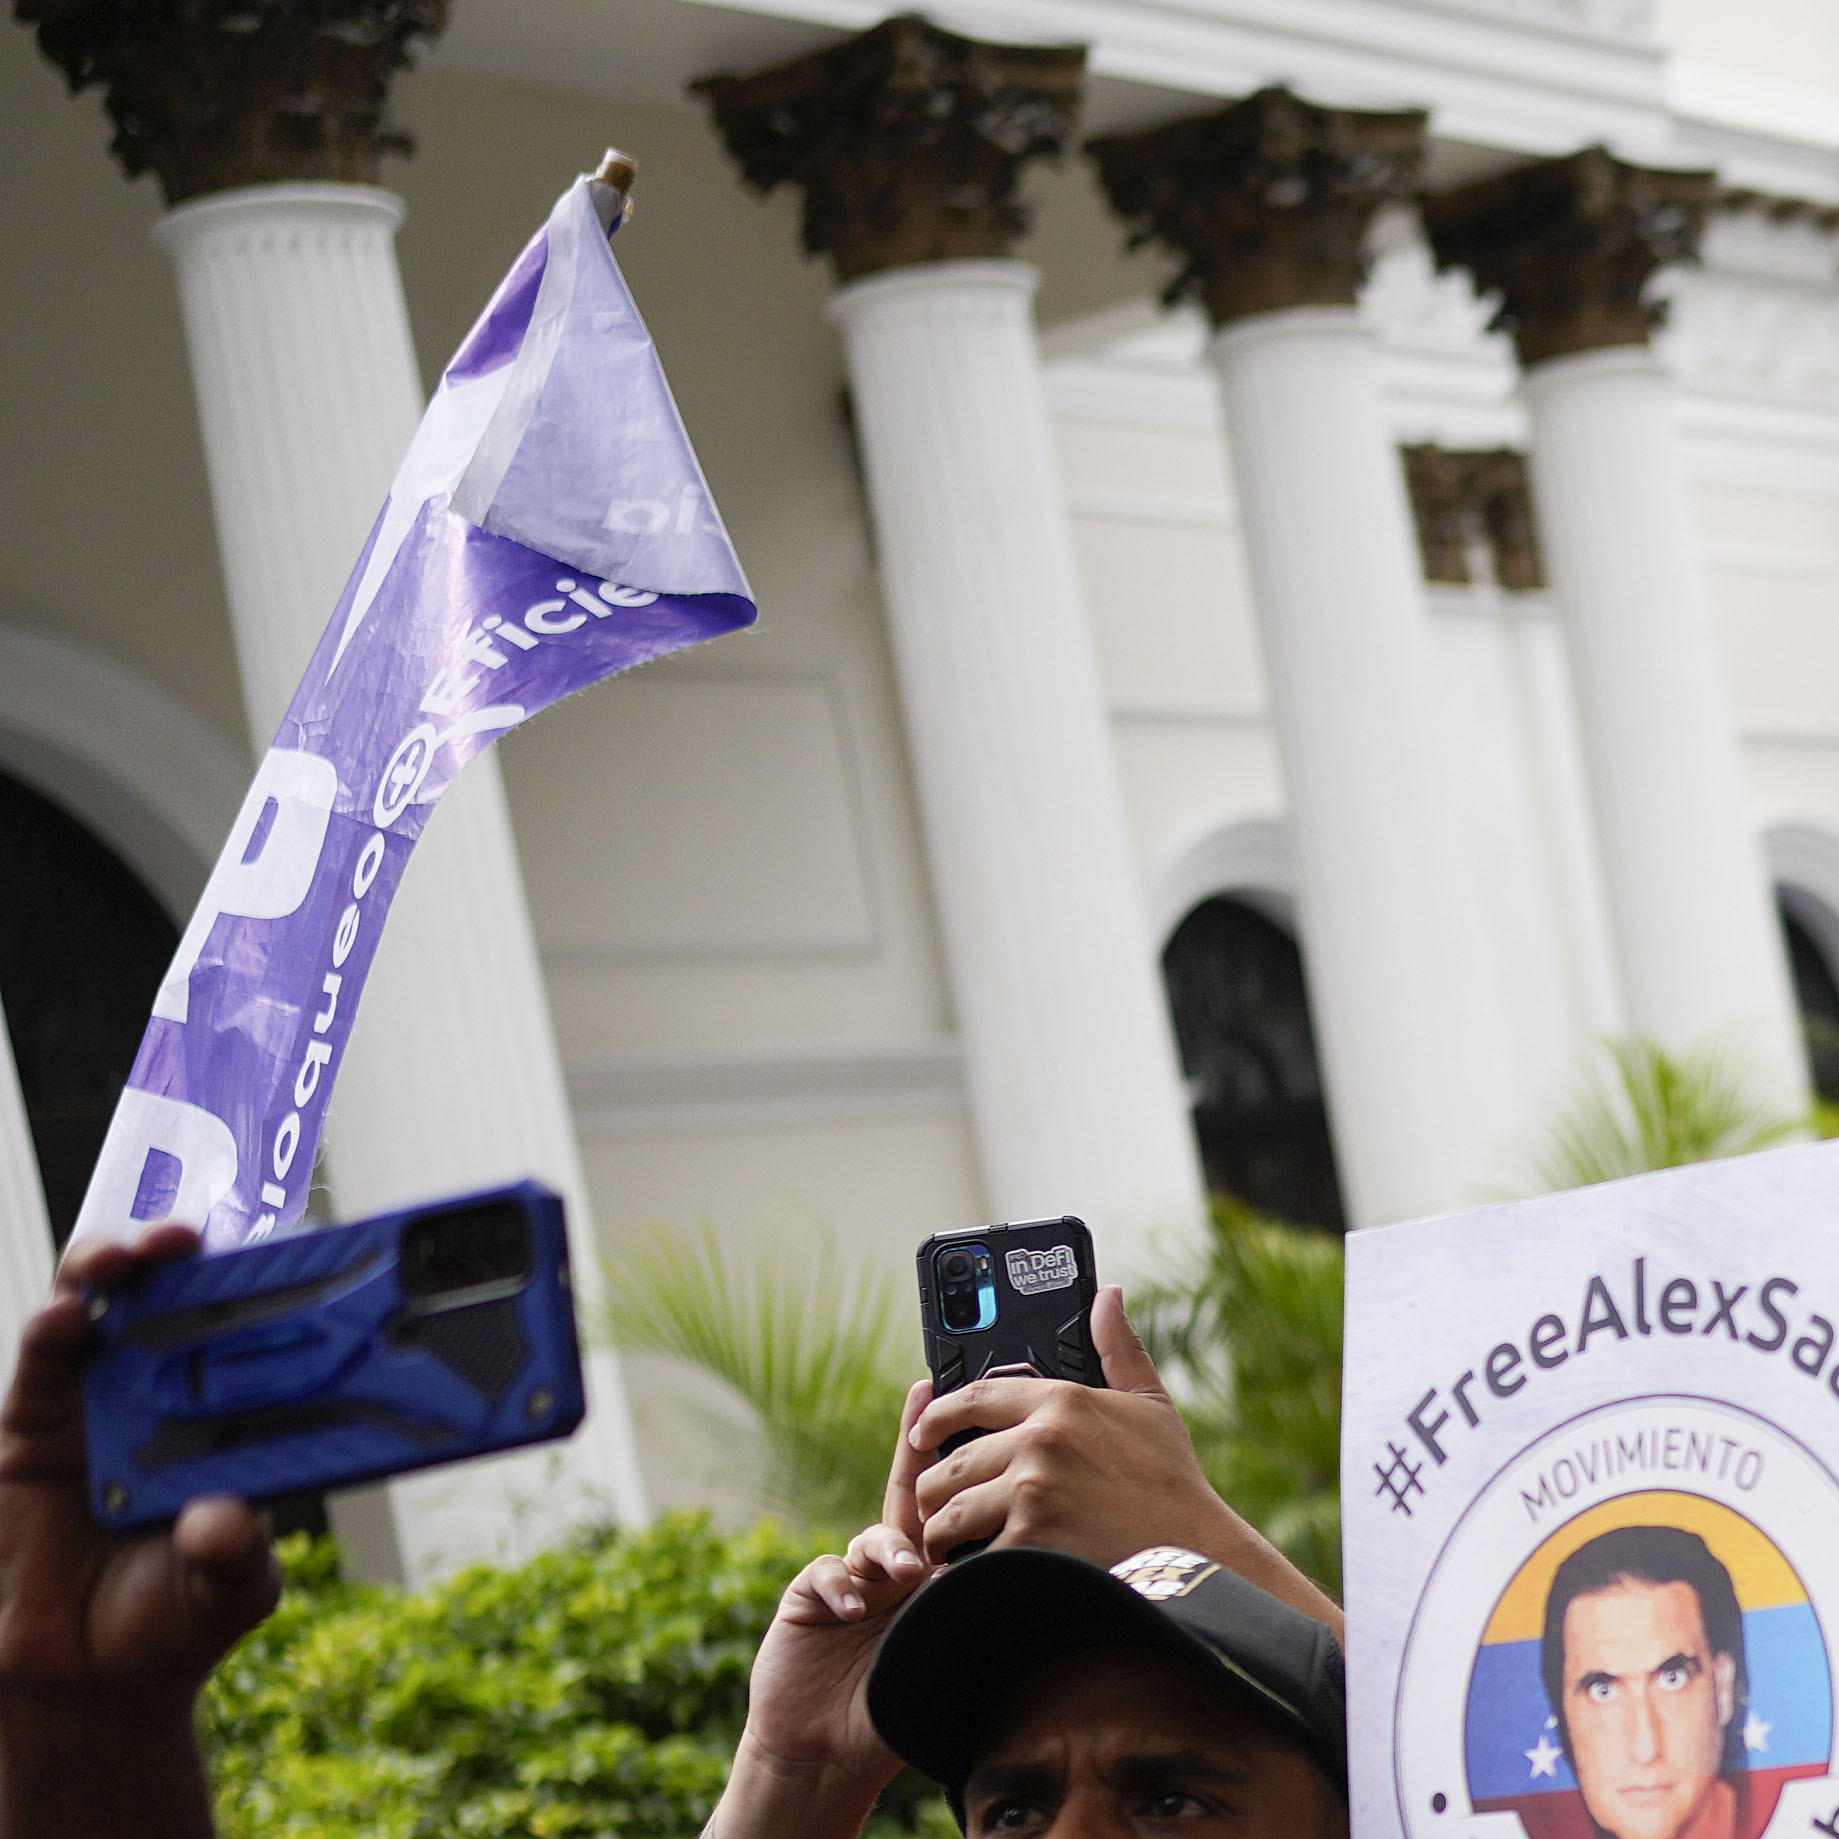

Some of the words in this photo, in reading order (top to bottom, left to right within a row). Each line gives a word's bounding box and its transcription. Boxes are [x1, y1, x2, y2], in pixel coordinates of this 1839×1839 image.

[1010, 1260, 1029, 1275] in
[1013, 1273, 1037, 1286] we
[1038, 1264, 1075, 1281] trust
[1519, 1427, 1765, 1523] MOVIMIENTO
